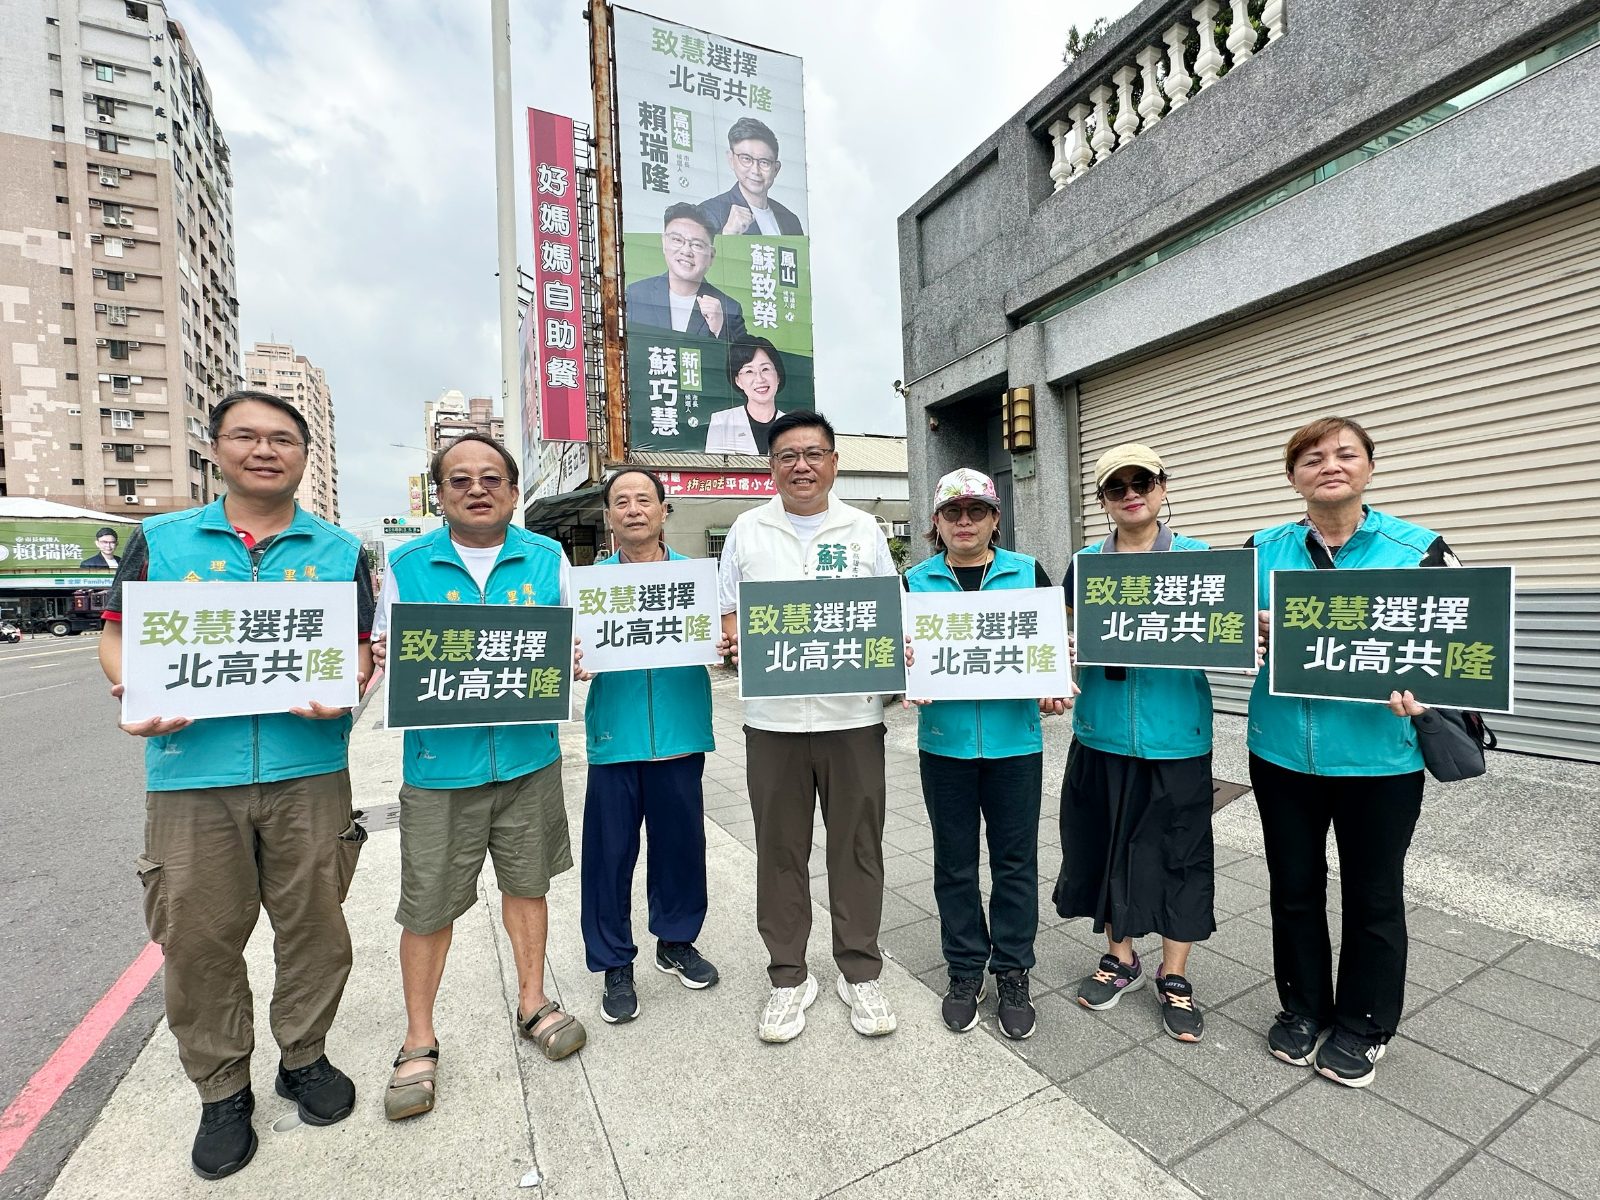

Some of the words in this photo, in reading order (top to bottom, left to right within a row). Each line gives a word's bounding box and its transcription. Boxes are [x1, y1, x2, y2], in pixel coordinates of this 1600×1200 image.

[651, 27, 758, 78] 致慧選擇
[669, 64, 772, 113] 北高共隆
[638, 101, 670, 194] 賴瑞隆
[673, 111, 691, 148] 高雄
[536, 163, 579, 389] 好媽媽自助餐
[750, 243, 778, 329] 蘇致榮
[780, 251, 796, 285] 鳳山
[681, 351, 699, 387] 新北
[648, 346, 680, 436] 蘇巧慧
[13, 543, 84, 560] 賴瑞隆
[815, 543, 849, 579] 蘇
[579, 581, 696, 616] 致慧選擇
[1084, 574, 1226, 607] 致慧選擇
[139, 608, 325, 647] 致慧選擇
[595, 613, 712, 649] 北高共隆
[748, 600, 877, 636] 致慧選擇
[913, 609, 1039, 642] 致慧選擇
[1101, 610, 1245, 645] 北高共隆
[1282, 594, 1470, 634] 致慧選擇
[399, 628, 547, 663] 致慧選擇
[765, 636, 896, 673] 北高共隆
[930, 642, 1058, 677] 北高共隆
[1303, 636, 1497, 681] 北高共隆
[165, 647, 346, 691] 北高共隆
[417, 667, 562, 702] 北高共隆
